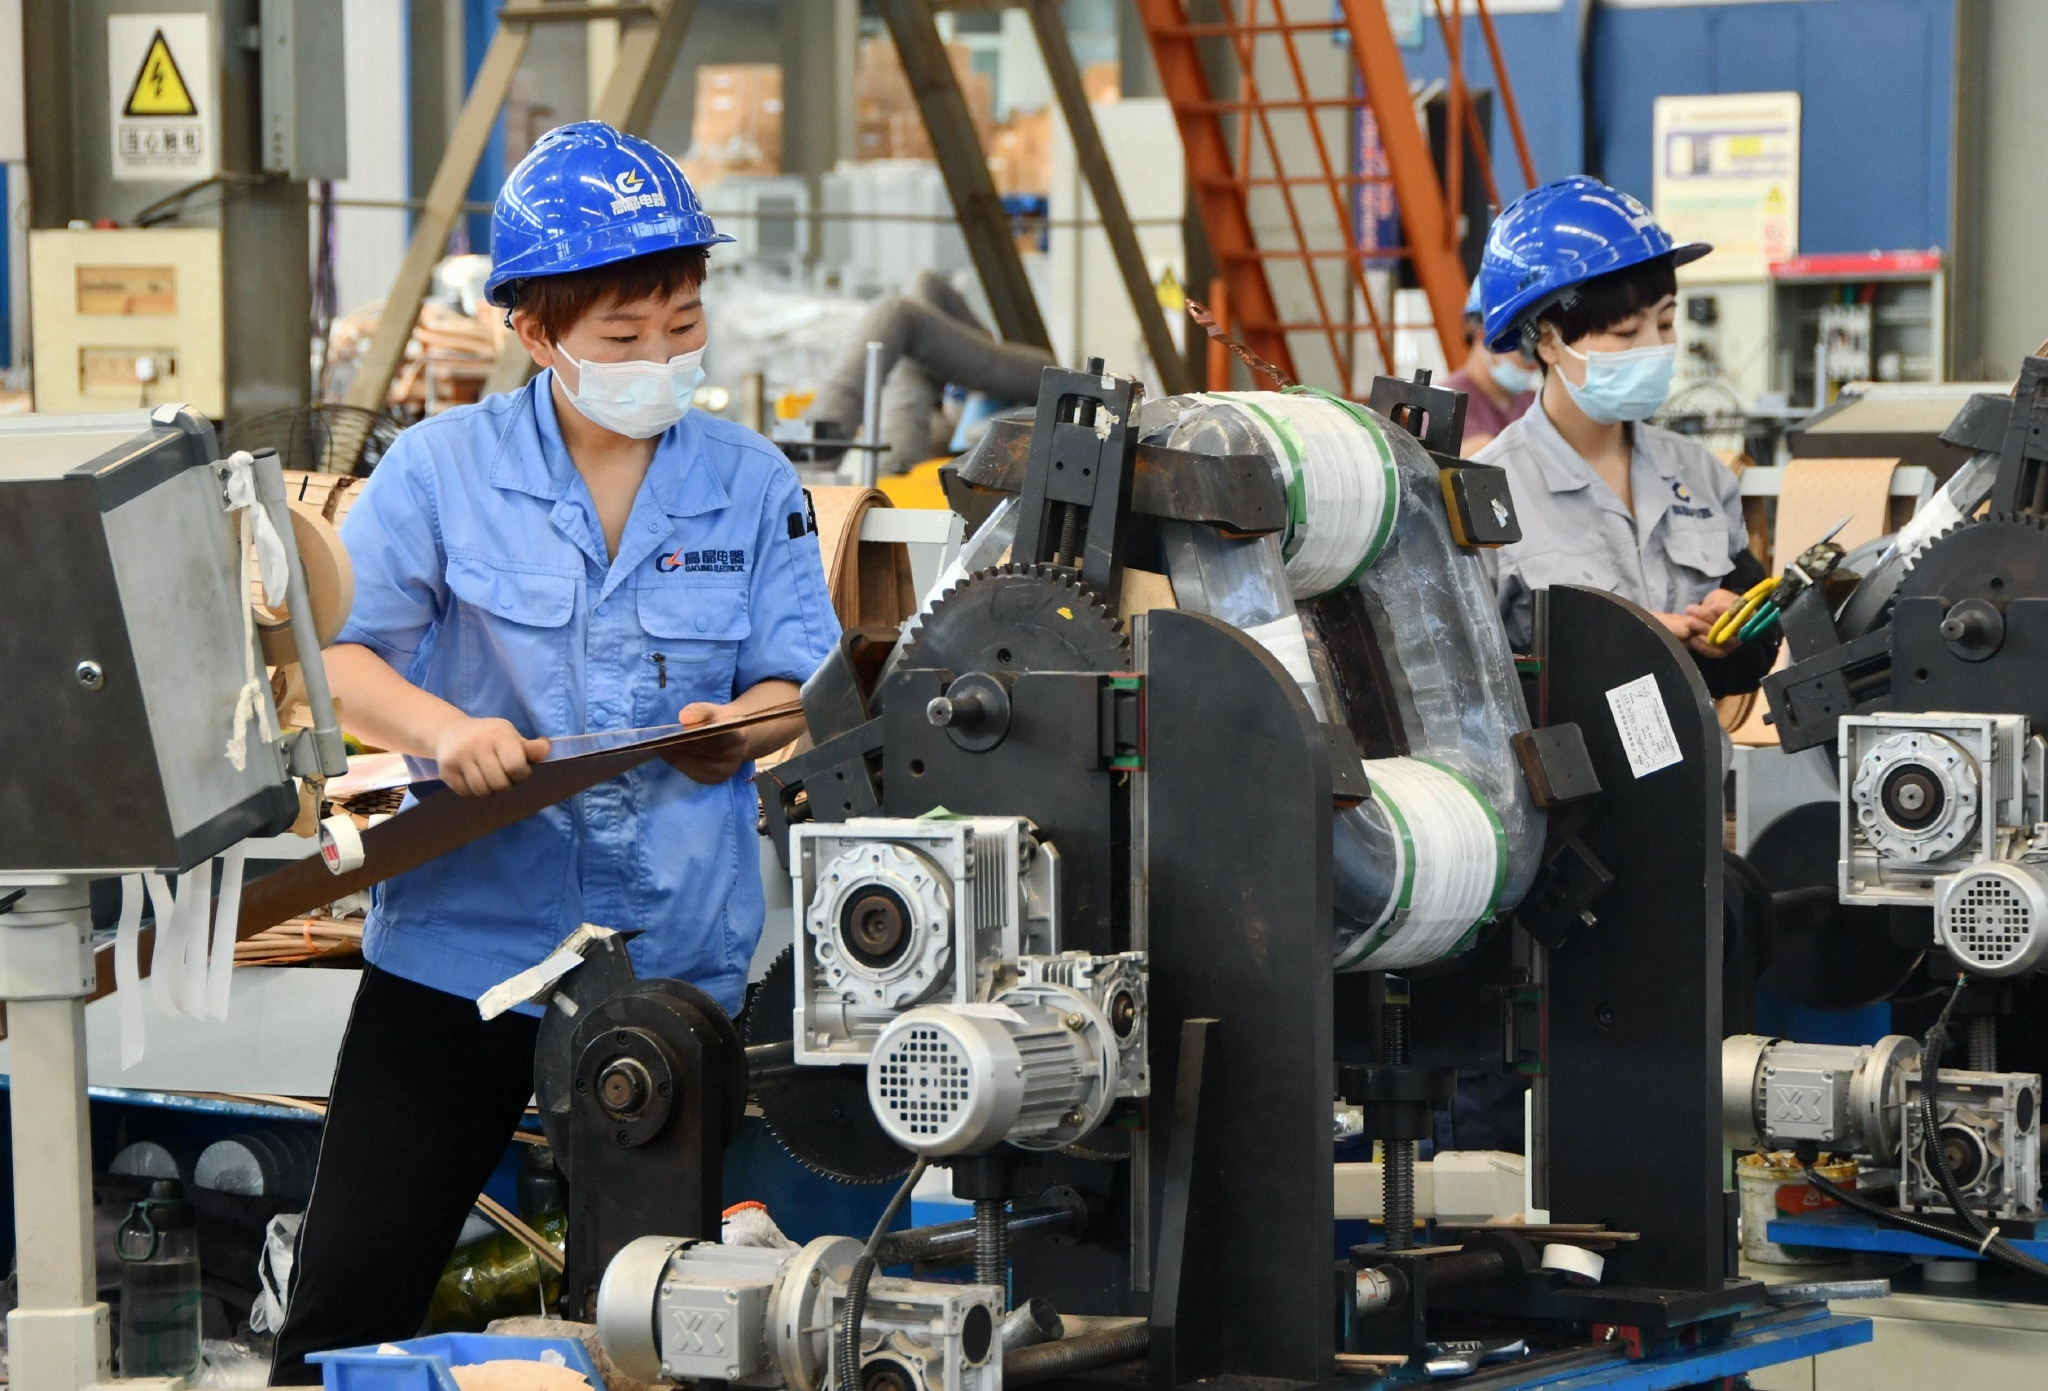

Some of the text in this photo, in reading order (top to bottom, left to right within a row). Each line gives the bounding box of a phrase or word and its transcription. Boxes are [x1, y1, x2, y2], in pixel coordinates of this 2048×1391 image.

[126, 129, 197, 152] 当心触电
[684, 549, 745, 565] 高晶电器
[685, 564, 714, 573] GAOJING
